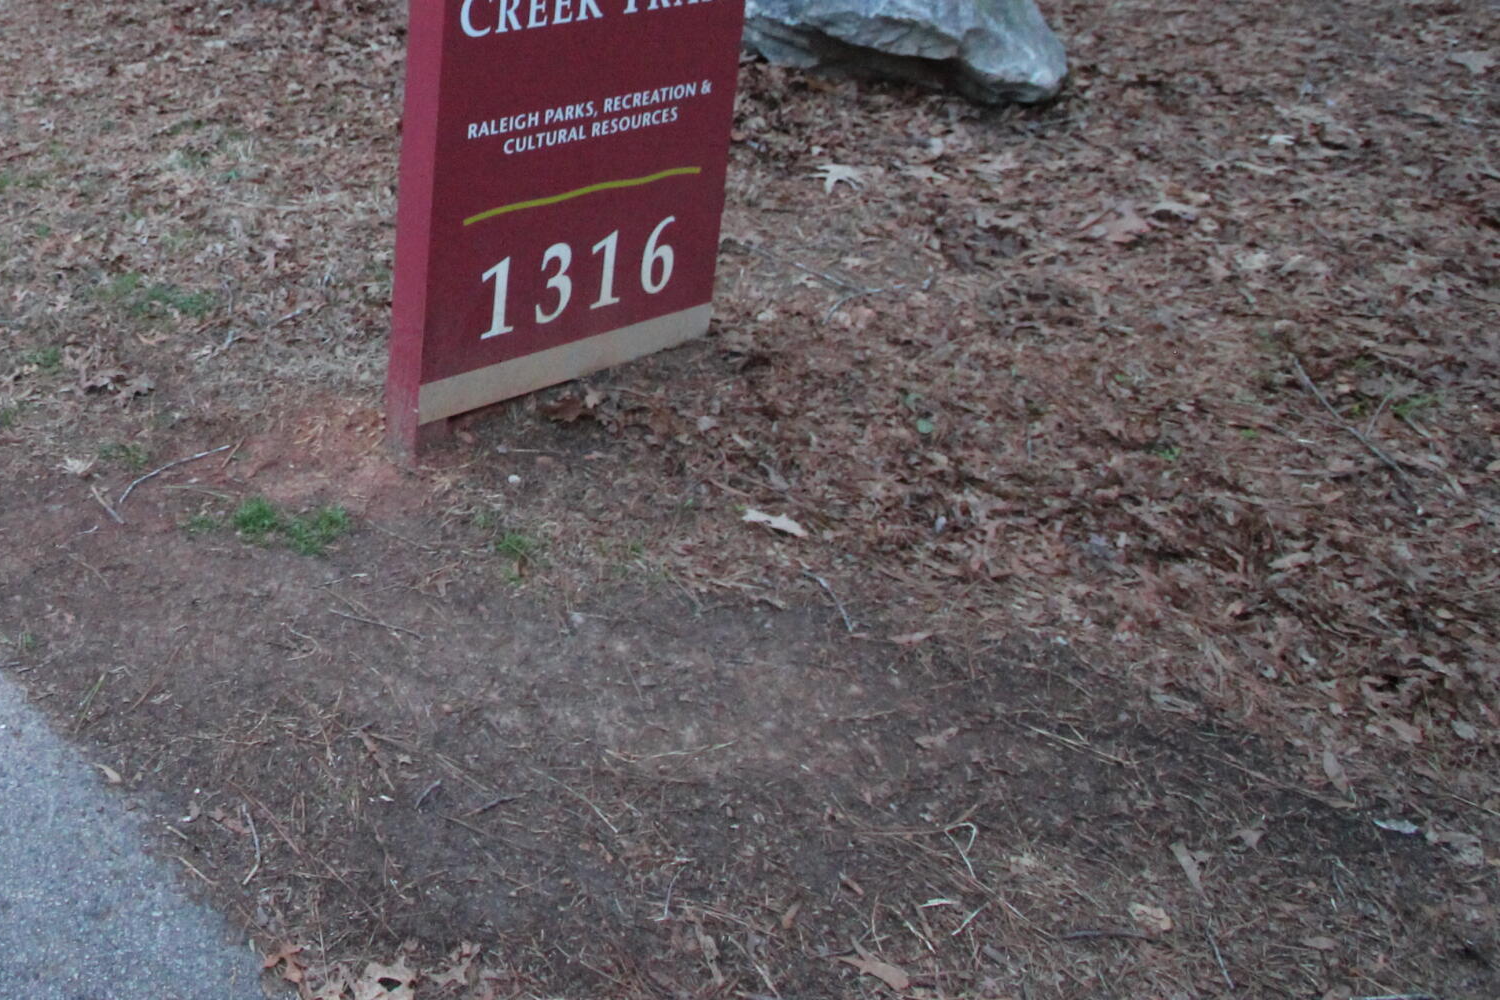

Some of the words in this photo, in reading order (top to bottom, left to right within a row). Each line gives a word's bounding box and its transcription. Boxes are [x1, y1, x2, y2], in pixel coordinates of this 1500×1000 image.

[467, 111, 540, 140] RALEIGH
[544, 100, 598, 126] PARKS,
[603, 82, 697, 114] RECREATION
[700, 79, 712, 95] &
[503, 126, 587, 155] CULTURAL
[591, 106, 679, 137] RESOURCES
[479, 215, 677, 341] 1316
